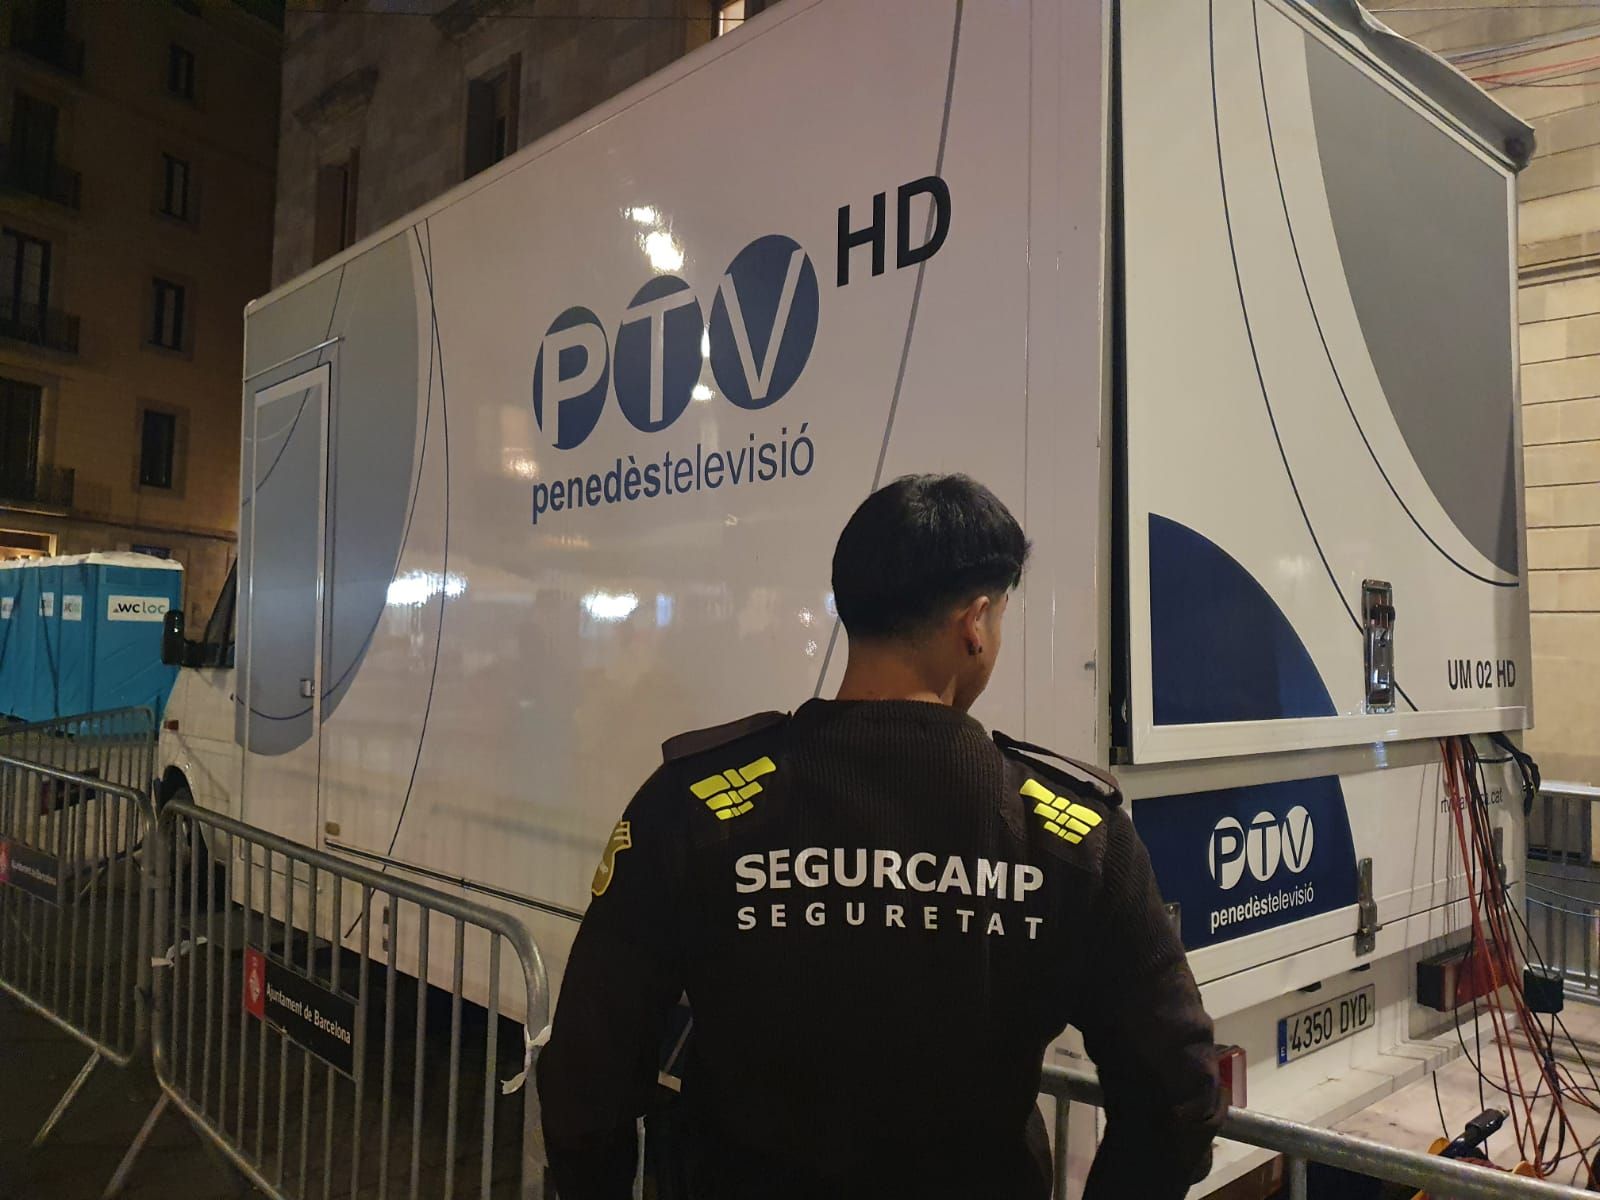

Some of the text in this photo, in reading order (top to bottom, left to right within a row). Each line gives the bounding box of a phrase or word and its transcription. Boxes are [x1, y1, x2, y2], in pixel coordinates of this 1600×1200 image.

[837, 175, 952, 288] HD
[535, 238, 816, 450] PTV
[532, 422, 815, 525] penedèstelevisió
[1447, 658, 1516, 690] UM 02 HD
[735, 847, 1044, 902] SEGURCAMP
[1209, 806, 1314, 890] PTV
[737, 902, 1043, 940] SEGURETAT
[1210, 881, 1315, 935] penedèstelevisió
[266, 982, 352, 1045] Ajuntament de Barcelona
[1291, 992, 1368, 1052] 4350 DYD
